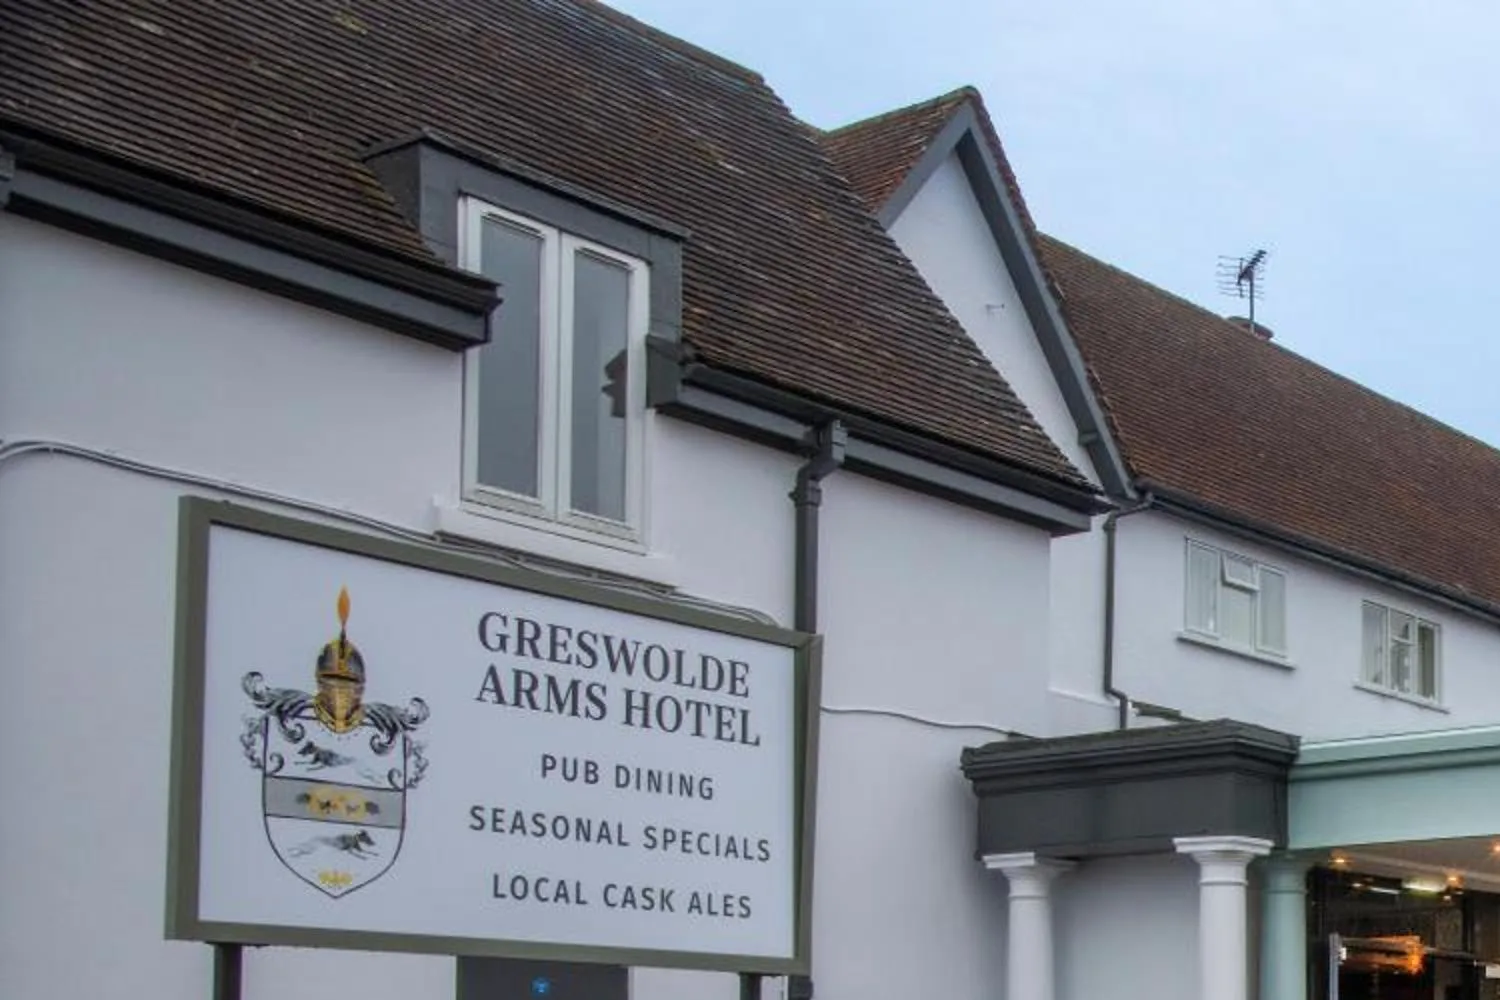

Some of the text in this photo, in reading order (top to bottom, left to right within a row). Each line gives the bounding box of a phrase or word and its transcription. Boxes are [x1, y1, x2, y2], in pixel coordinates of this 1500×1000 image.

[477, 611, 750, 699] GRESWOLDE
[474, 663, 761, 747] ARMS HOTEL
[541, 753, 714, 801] PUB DINING
[468, 805, 771, 863] SEASONAL SPECIALS
[492, 873, 752, 919] LOCAL CASK ALES
